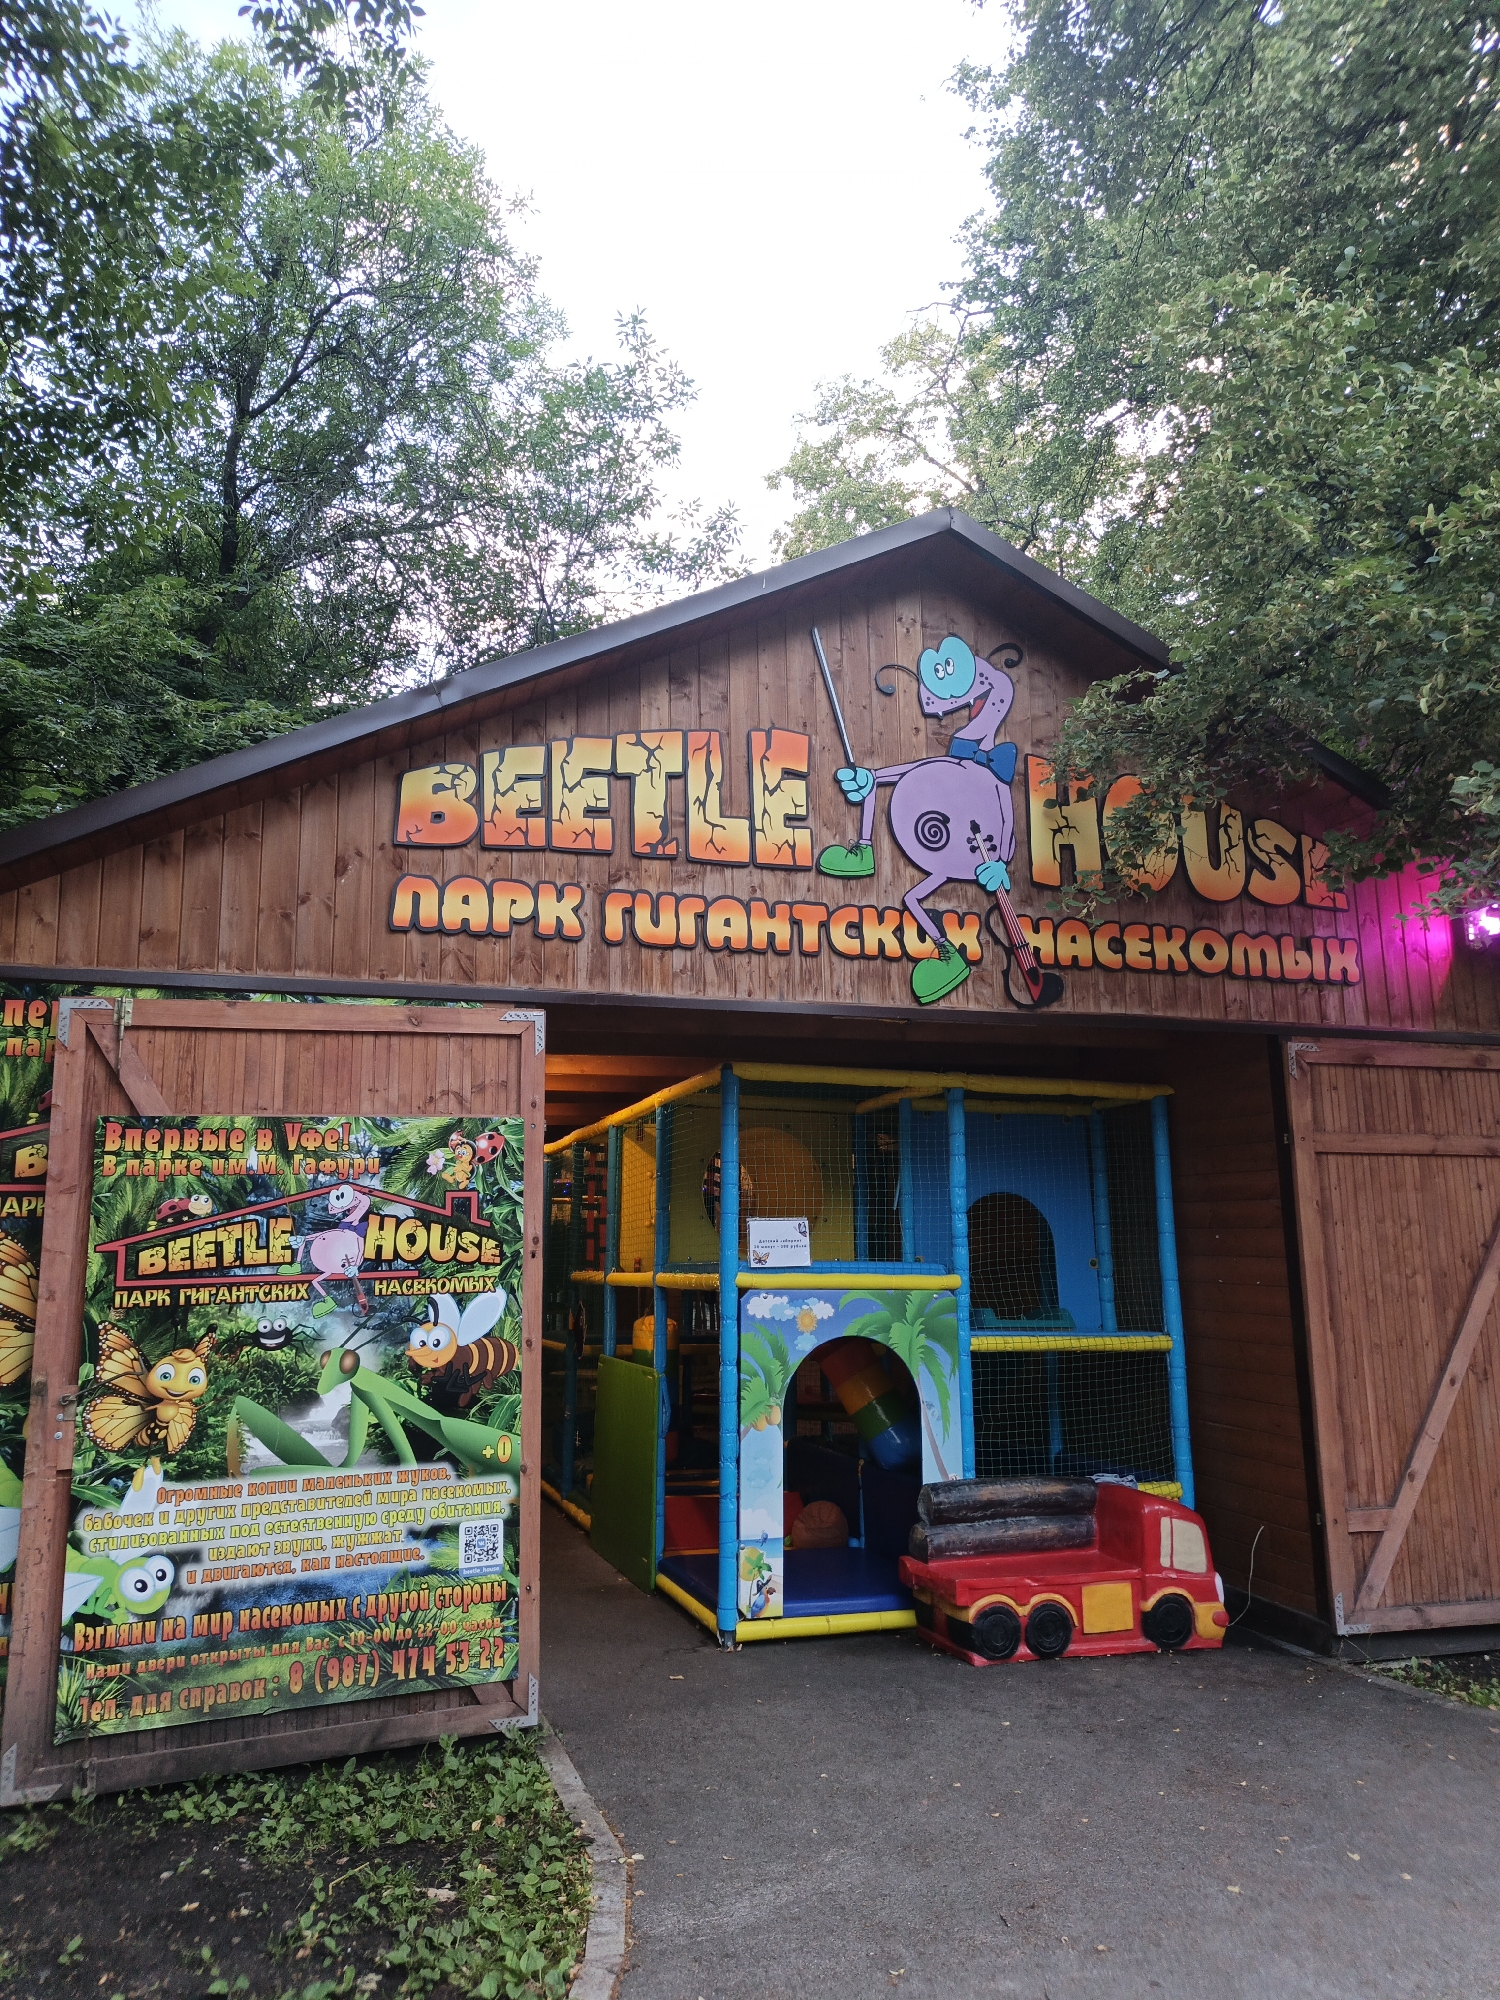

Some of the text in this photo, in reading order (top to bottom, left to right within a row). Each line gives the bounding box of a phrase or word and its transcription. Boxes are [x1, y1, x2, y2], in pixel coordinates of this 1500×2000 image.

[394, 727, 813, 869] BEETLE
[390, 874, 1360, 986] ПАРК ГИГАНТСКИХ НАСЕКОМЫХ
[103, 1122, 352, 1159] Впервые в Уфе!
[125, 1158, 203, 1182] парке
[292, 1153, 381, 1180] Гафури
[137, 1213, 501, 1277] BEETLE HOUSE
[114, 1276, 497, 1309] ПАРК ГИГАНТСКИХ НАСЕКОМЫХ
[83, 1479, 512, 1532] бабочек и других представителей мира насекомых,
[157, 1466, 451, 1507] Огромные копии маленьких жуков,
[89, 1500, 506, 1553] стилизованных под естественную среду обитания,
[208, 1528, 402, 1562] издают звуки, жужжат
[187, 1546, 425, 1585] и двигаются, как настоящие.
[73, 1580, 508, 1653] Взгляни на мир насекомых с другой стороны
[86, 1662, 131, 1680] Наши
[136, 1655, 186, 1674] двери
[190, 1645, 266, 1666] открыты
[271, 1640, 300, 1656] для
[305, 1636, 330, 1652] Вас
[338, 1635, 345, 1648] с
[350, 1627, 391, 1646] 10-00
[396, 1626, 412, 1641] до
[417, 1619, 457, 1638] 22-00
[79, 1697, 124, 1723] Тел.
[129, 1690, 173, 1718] для
[179, 1677, 267, 1713] справок
[289, 1660, 304, 1694] 8
[314, 1650, 381, 1694] (987)
[392, 1645, 436, 1680] 474
[445, 1641, 470, 1674] 53
[479, 1636, 505, 1670] 22
